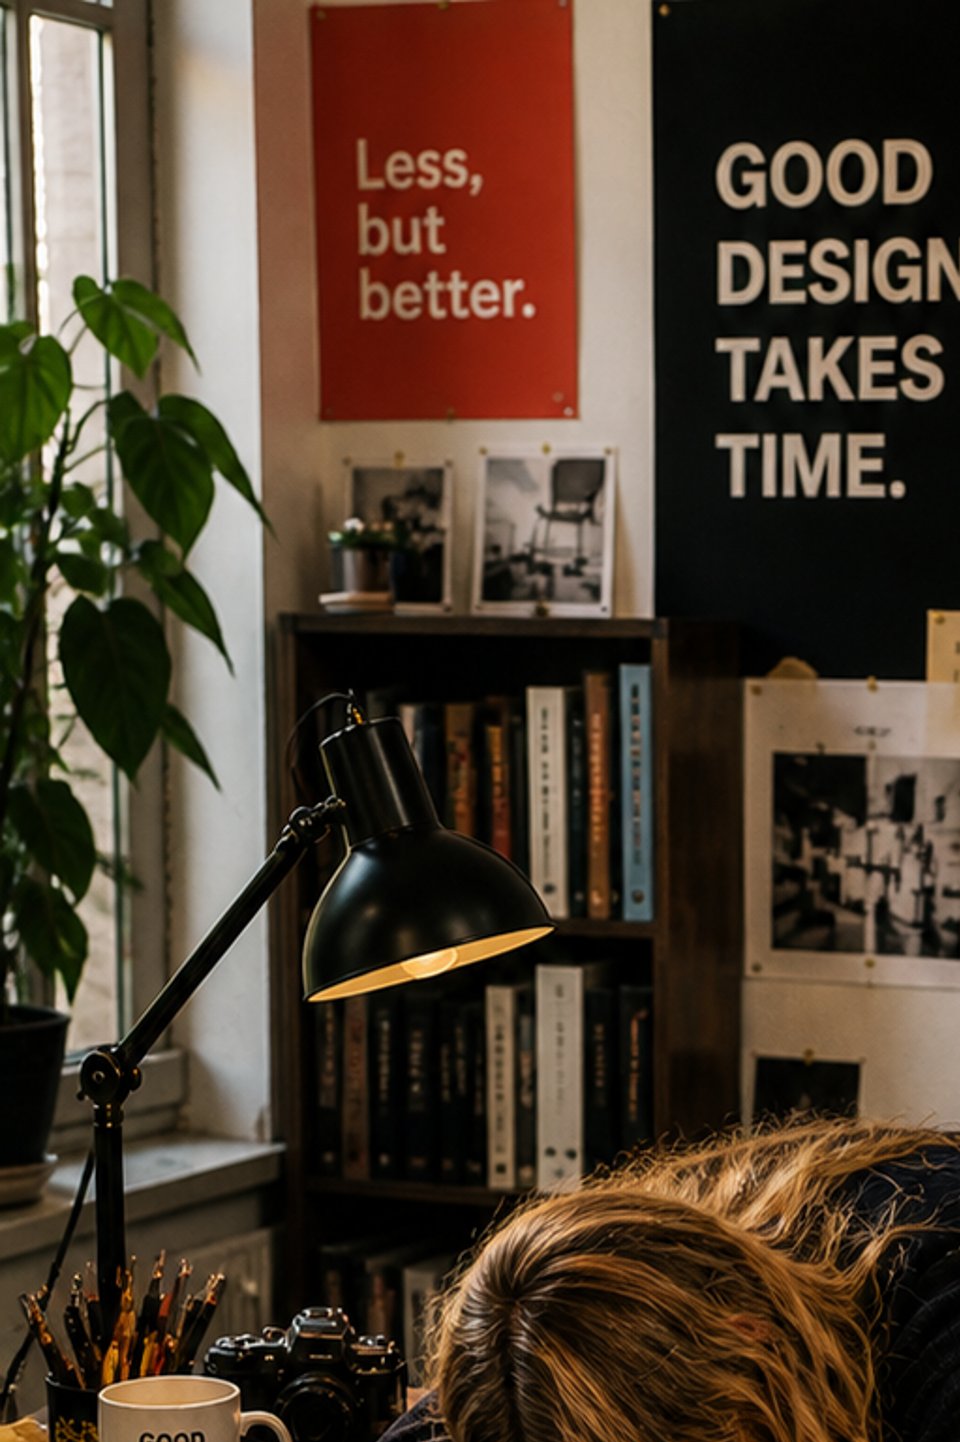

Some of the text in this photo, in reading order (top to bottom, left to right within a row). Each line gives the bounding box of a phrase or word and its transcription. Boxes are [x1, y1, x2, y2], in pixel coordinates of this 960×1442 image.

[358, 139, 483, 196] Less,
[716, 139, 933, 209] GOOD
[359, 203, 446, 255] but
[361, 267, 536, 319] better.
[715, 334, 944, 402] TAKES
[715, 433, 906, 498] TIME.
